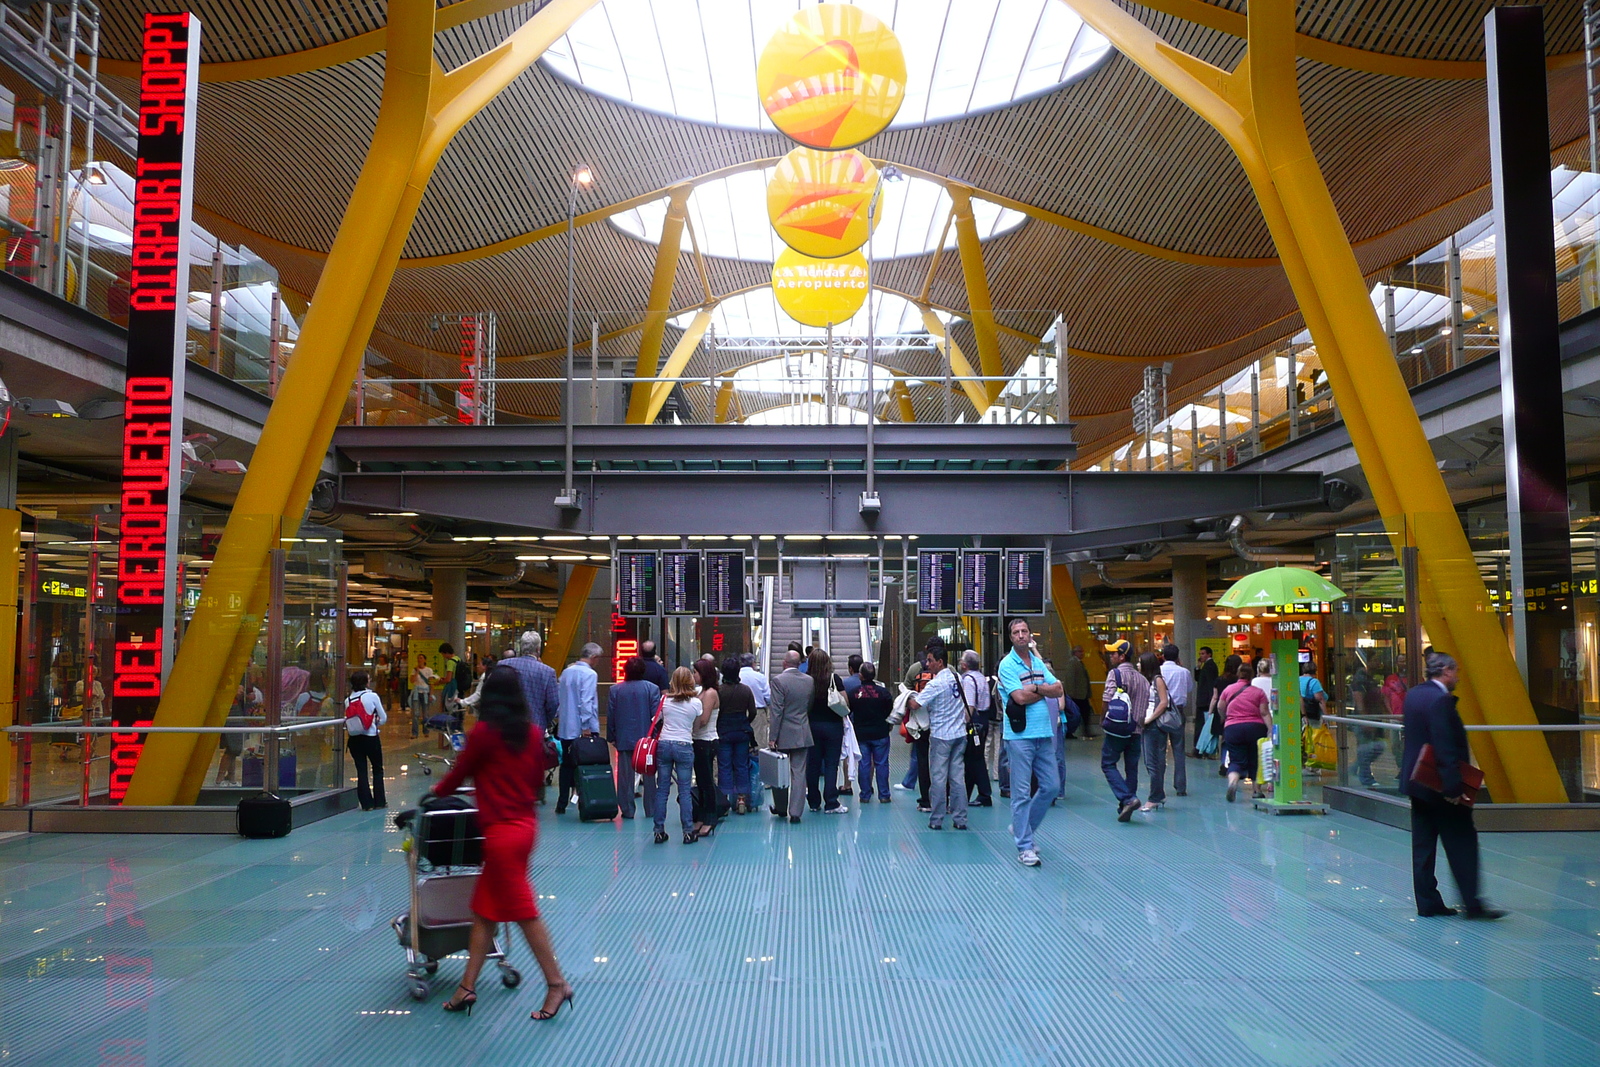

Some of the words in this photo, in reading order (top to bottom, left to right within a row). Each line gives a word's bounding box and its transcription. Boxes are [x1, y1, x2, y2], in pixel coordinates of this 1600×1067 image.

[140, 13, 190, 136] SHOPPI
[130, 158, 182, 311] AIRPORT
[777, 279, 866, 290] Aeropuerto
[797, 266, 845, 278] Tiendas
[849, 267, 867, 278] del
[118, 377, 172, 604] AEROPUERTO
[114, 628, 162, 697] DEL
[1285, 653, 1297, 789] BIENVENIDO
